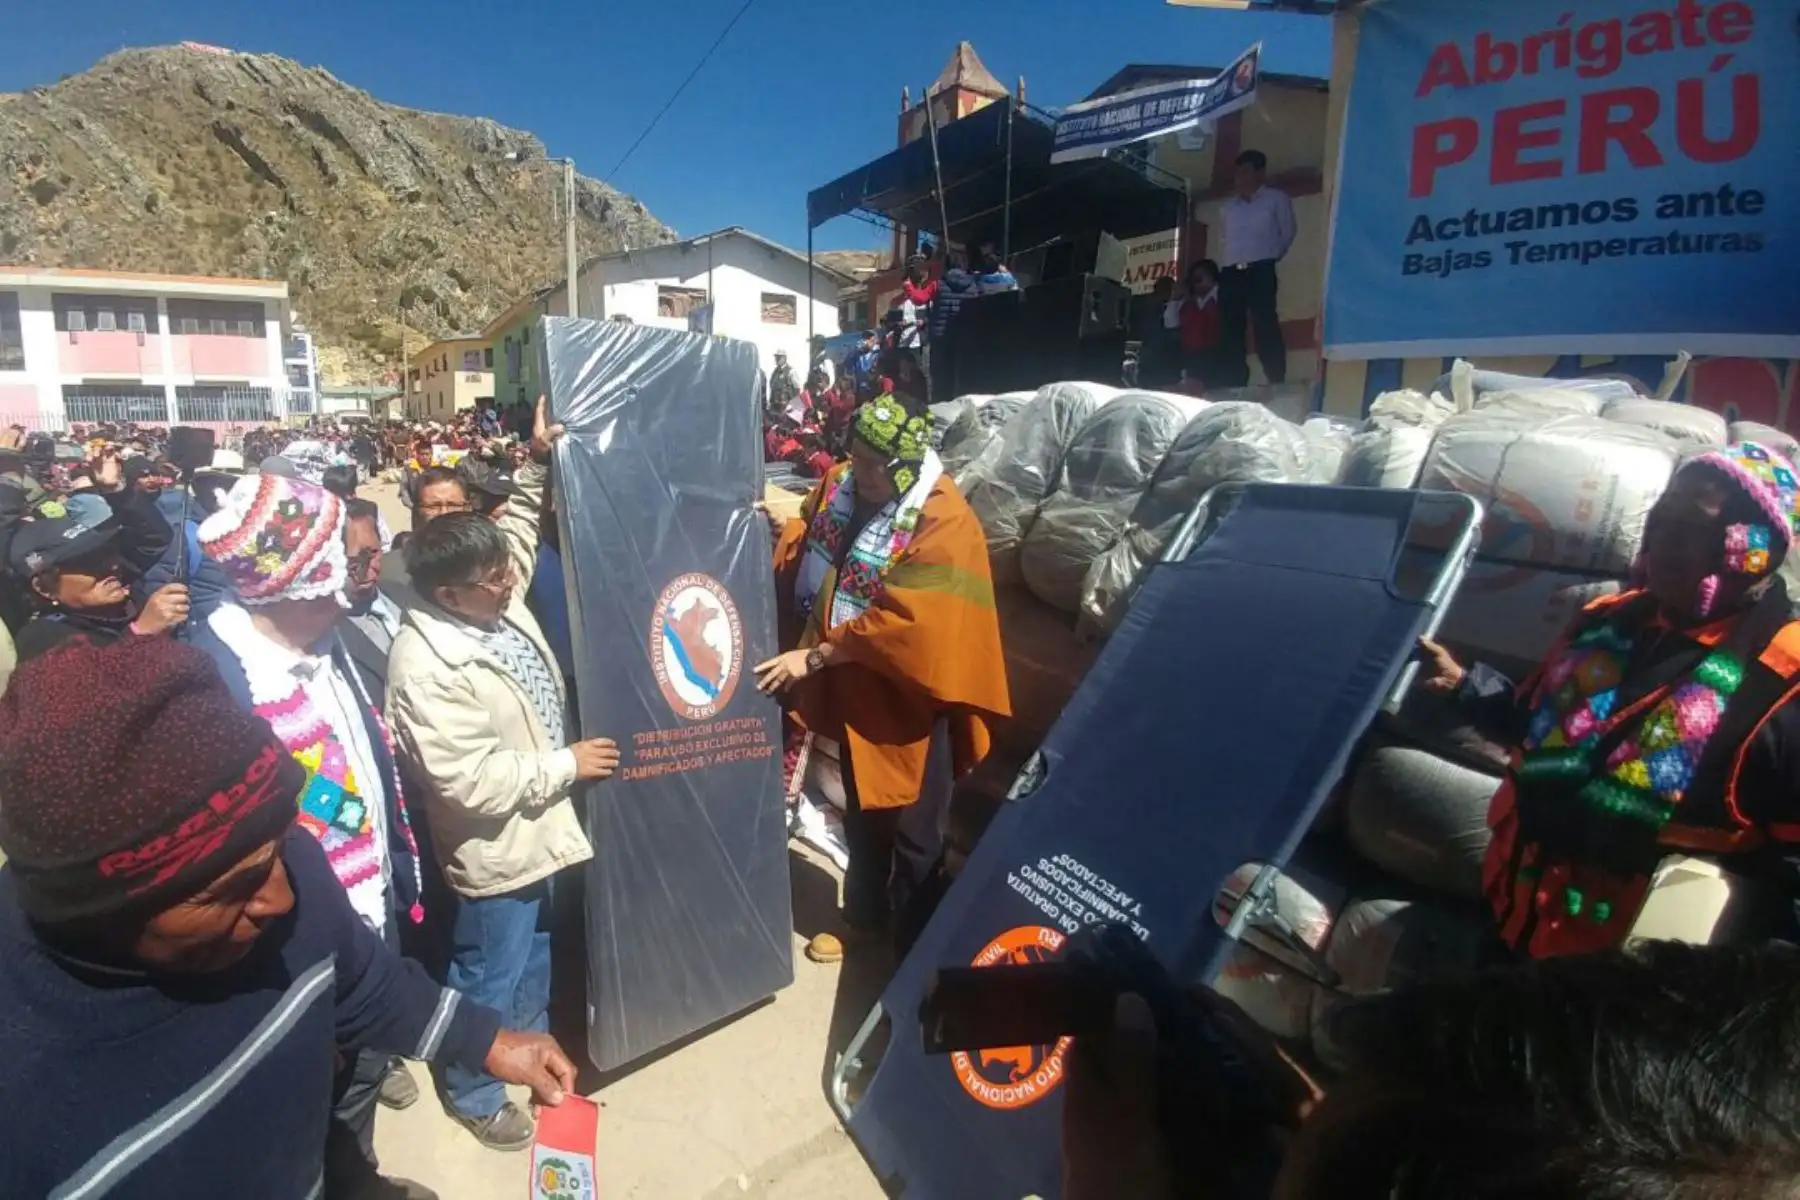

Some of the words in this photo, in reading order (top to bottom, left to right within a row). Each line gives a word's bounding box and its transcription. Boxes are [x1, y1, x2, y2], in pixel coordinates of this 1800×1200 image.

[1415, 0, 1754, 98] Abrígate
[1143, 101, 1158, 117] DE
[1159, 92, 1206, 114] DEFENSA
[1408, 54, 1760, 199] PERÚ
[1404, 195, 1638, 246] Actuamos
[1655, 183, 1765, 220] ante
[1402, 246, 1492, 278] Bajas
[1504, 229, 1764, 266] Temperaturas
[695, 733, 752, 751] EXCLUSIVO
[752, 731, 766, 742] DE
[622, 756, 705, 780] DAMNIFICADOS
[1007, 871, 1059, 918] GRATUITA
[1020, 865, 1085, 917] EXCLUSIVO
[1130, 903, 1142, 917] Y
[967, 1069, 1036, 1102] NACIONAL
